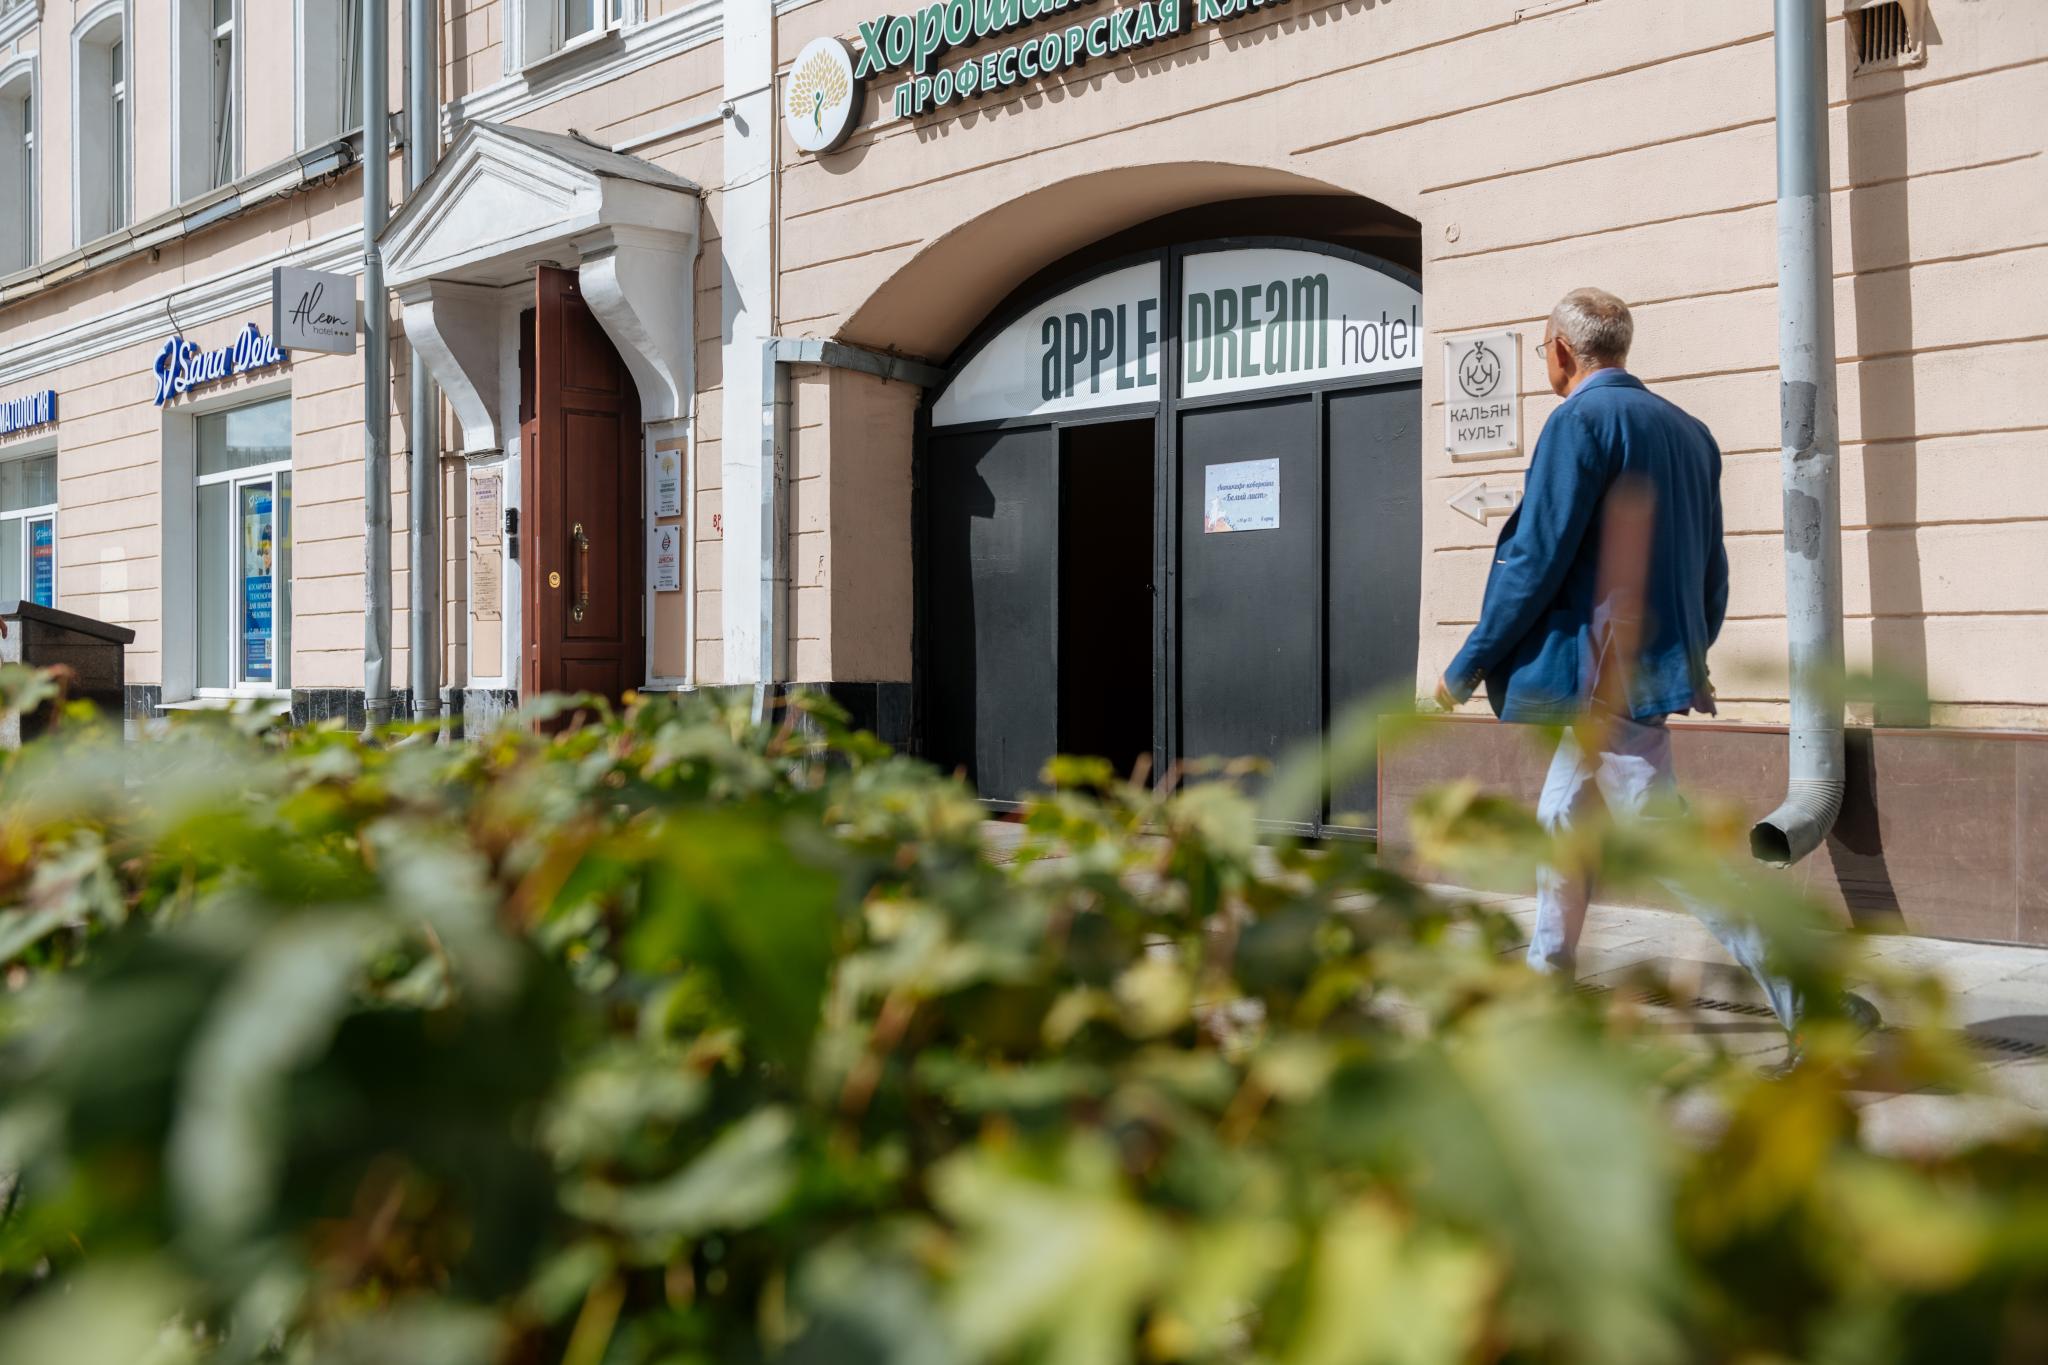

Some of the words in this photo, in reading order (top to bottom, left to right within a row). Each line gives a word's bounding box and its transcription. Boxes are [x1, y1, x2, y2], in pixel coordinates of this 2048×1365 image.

[855, 0, 1079, 79] Хорош
[894, 0, 1180, 117] ПРОФЕССОРСКАЯ
[174, 340, 226, 392] Sana
[233, 325, 281, 373] Den
[313, 325, 334, 336] hotel
[1341, 304, 1417, 366] hotel
[1450, 402, 1510, 423] КАЛЬЯН
[1458, 424, 1504, 441] КУЛЬТ
